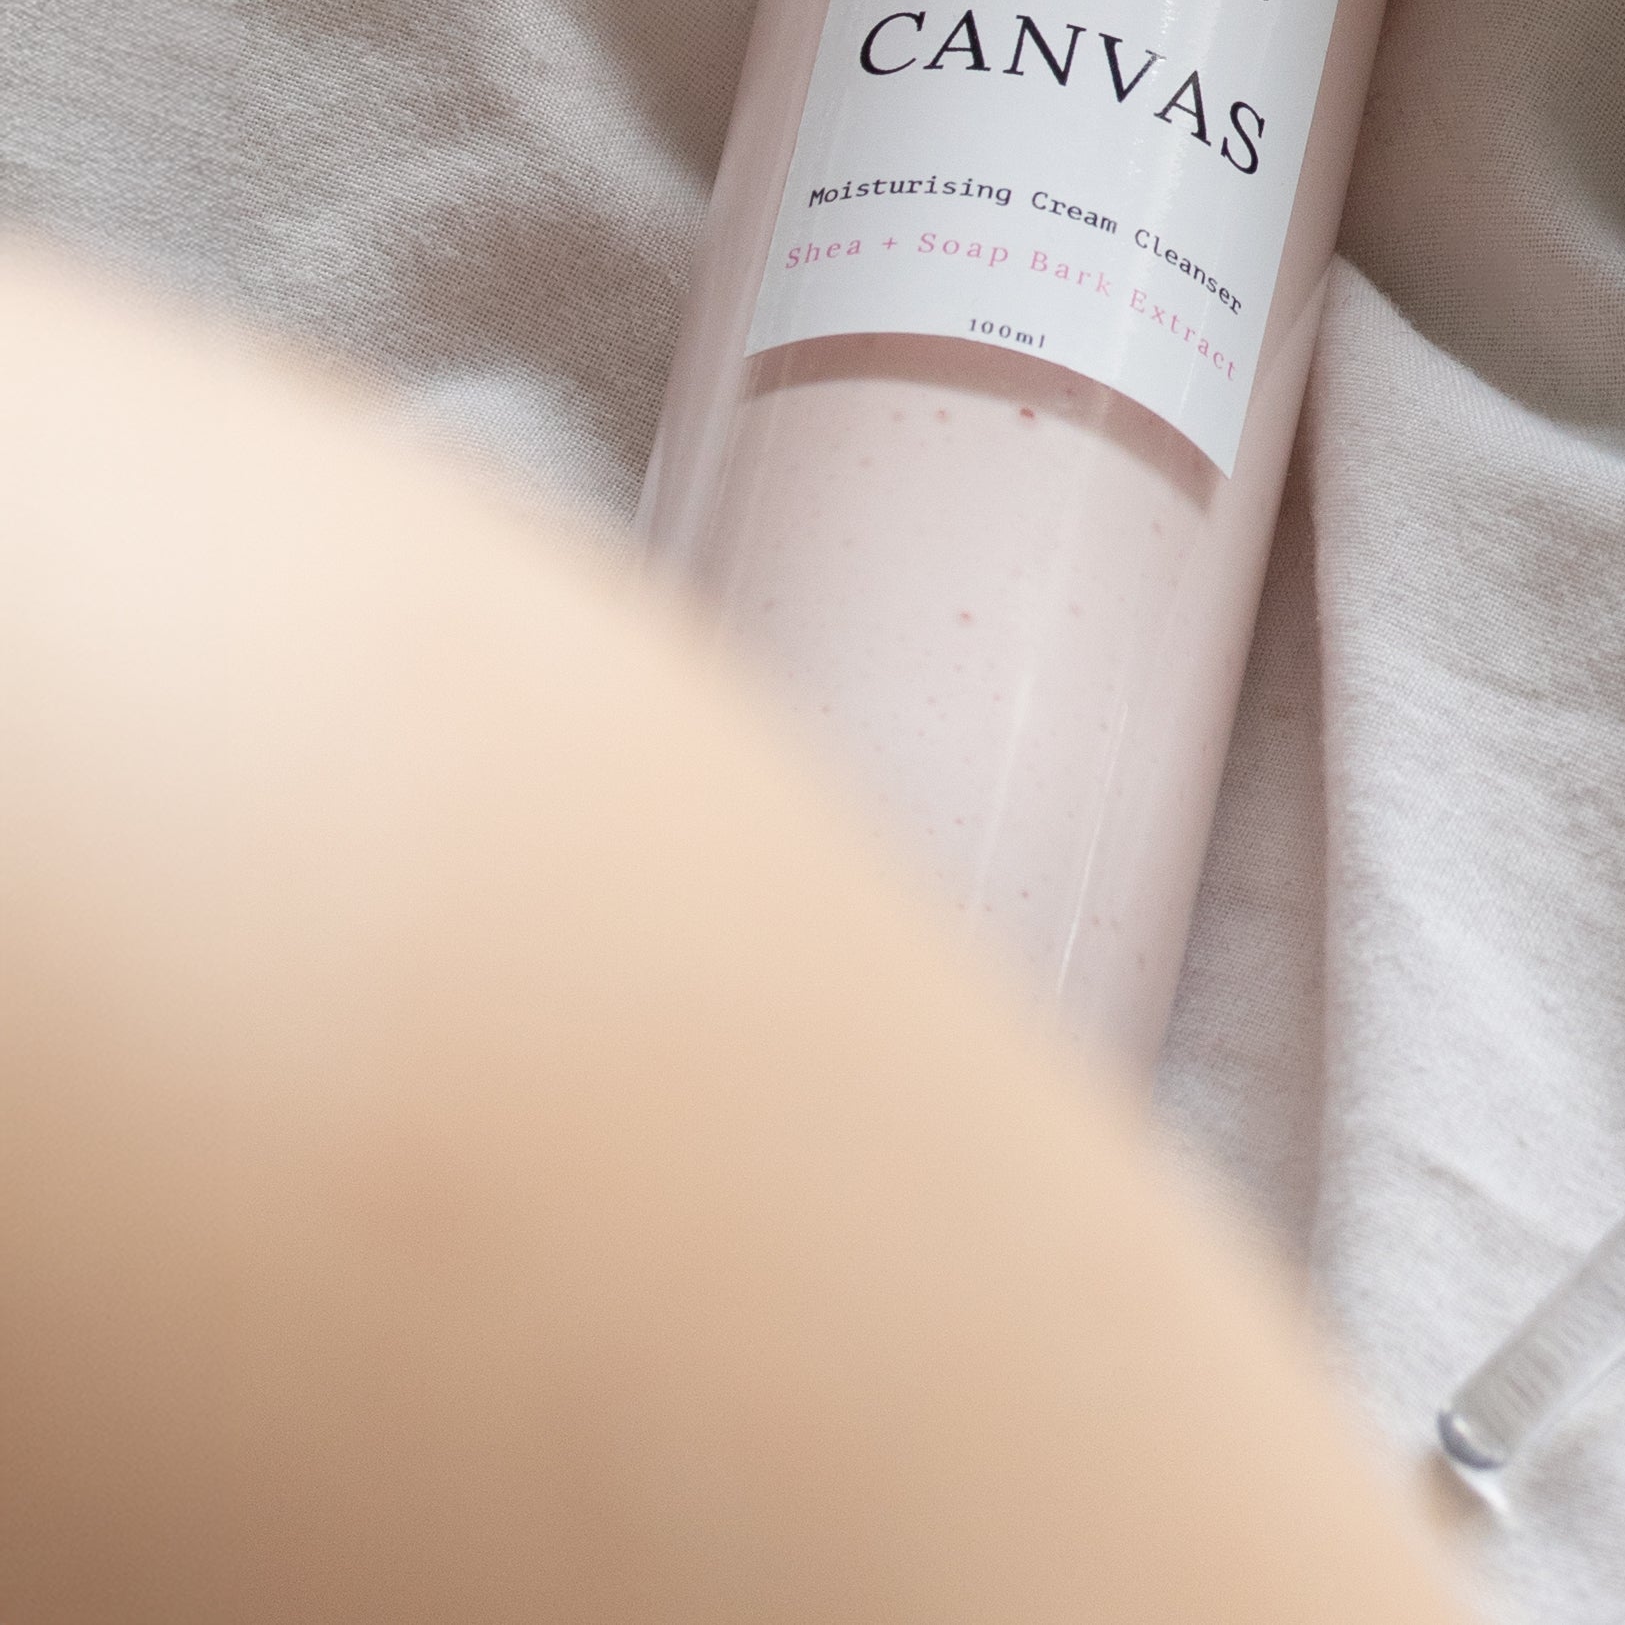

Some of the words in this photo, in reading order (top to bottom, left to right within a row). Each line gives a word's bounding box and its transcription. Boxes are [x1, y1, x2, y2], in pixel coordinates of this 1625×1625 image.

[859, 9, 1267, 176] CANVAS
[785, 239, 862, 269] Shea
[882, 237, 898, 250] +
[918, 232, 1009, 267] Soap
[1029, 251, 1112, 296] Bark
[1129, 288, 1236, 381] Extract
[808, 175, 1012, 207] Moisturising
[1031, 191, 1118, 234] Cream
[1134, 229, 1242, 315] Cleanser
[968, 318, 1045, 348] 100ml
